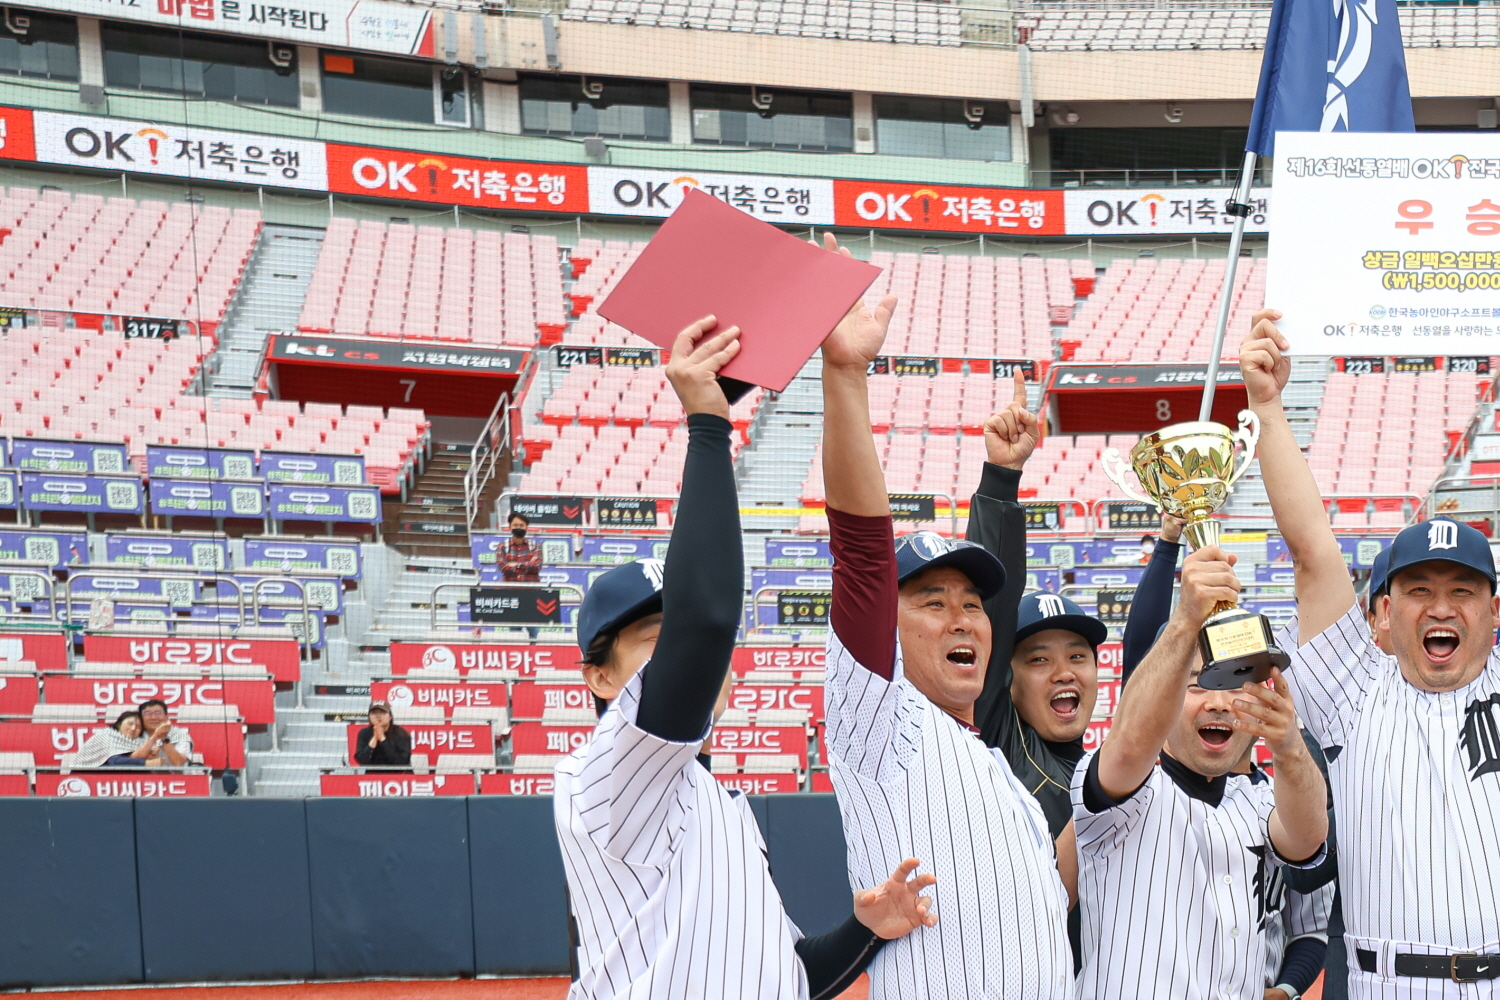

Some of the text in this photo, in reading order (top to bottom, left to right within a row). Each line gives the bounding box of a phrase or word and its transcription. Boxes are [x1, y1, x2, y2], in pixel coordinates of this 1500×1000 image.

[249, 7, 329, 32] 시작된다
[174, 138, 301, 180] 저축은행
[1288, 157, 1342, 178] 제16회
[1344, 158, 1408, 178] 선동열배
[451, 166, 566, 206] 저축은행
[943, 196, 1045, 229] 저축은행
[1362, 251, 1399, 269] 상금
[128, 321, 159, 339] 317
[1359, 325, 1402, 337] 저축은행
[1412, 325, 1451, 337] 선동열을
[1454, 325, 1493, 337] 사랑하는
[285, 342, 334, 358] kt
[559, 351, 587, 366] 221
[1345, 361, 1372, 374] 223
[1451, 358, 1477, 372] 320
[1059, 373, 1101, 385] kt
[401, 380, 416, 403] 7
[1156, 400, 1170, 421] 8
[475, 596, 520, 609] 비씨카드존
[461, 650, 554, 676] 비씨카드
[418, 688, 491, 707] 비씨카드
[726, 689, 813, 718] 로카드
[95, 780, 187, 797] 비씨카드
